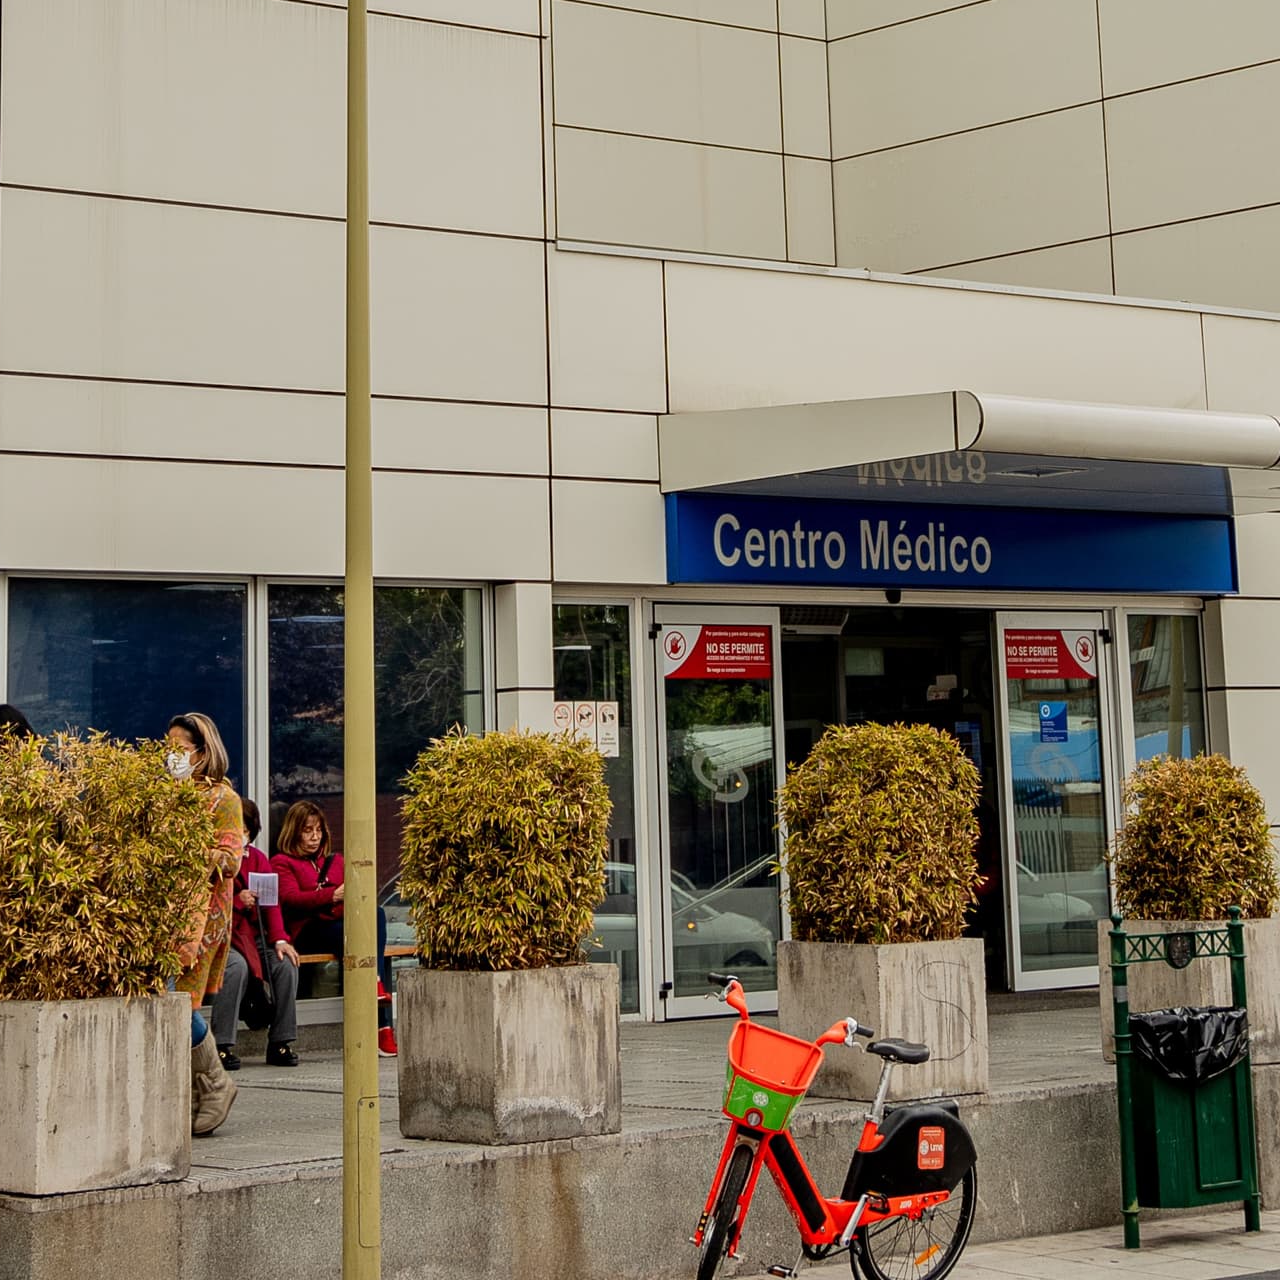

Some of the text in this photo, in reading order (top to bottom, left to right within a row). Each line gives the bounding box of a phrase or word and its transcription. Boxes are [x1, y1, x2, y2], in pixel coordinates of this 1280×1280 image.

[712, 512, 992, 574] Centro Médico
[706, 643, 765, 655] NO SE PERMITE
[1007, 646, 1058, 656] NO SE PERMITE
